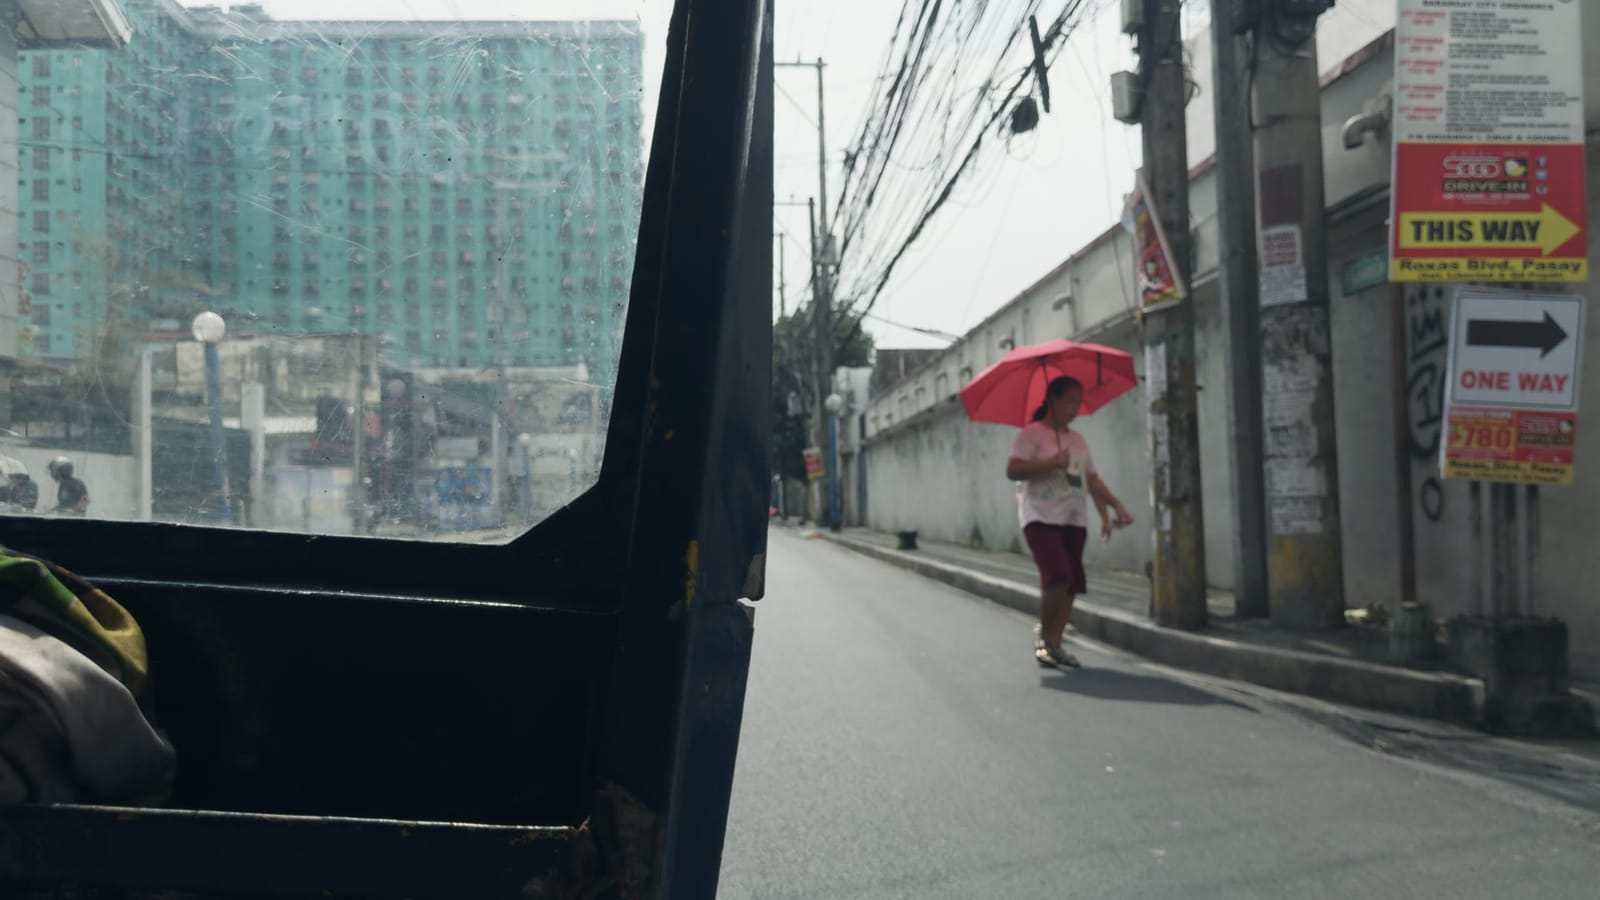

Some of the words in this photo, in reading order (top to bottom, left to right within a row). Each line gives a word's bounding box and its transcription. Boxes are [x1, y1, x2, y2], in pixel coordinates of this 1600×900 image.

[1443, 181, 1528, 192] DRIVE-IN
[1410, 220, 1473, 241] THIS
[1480, 220, 1541, 241] WAY
[1400, 260, 1459, 271] Roxas
[1522, 261, 1581, 272] Pasay
[1460, 370, 1510, 391] ONE
[1517, 373, 1569, 393] WAY
